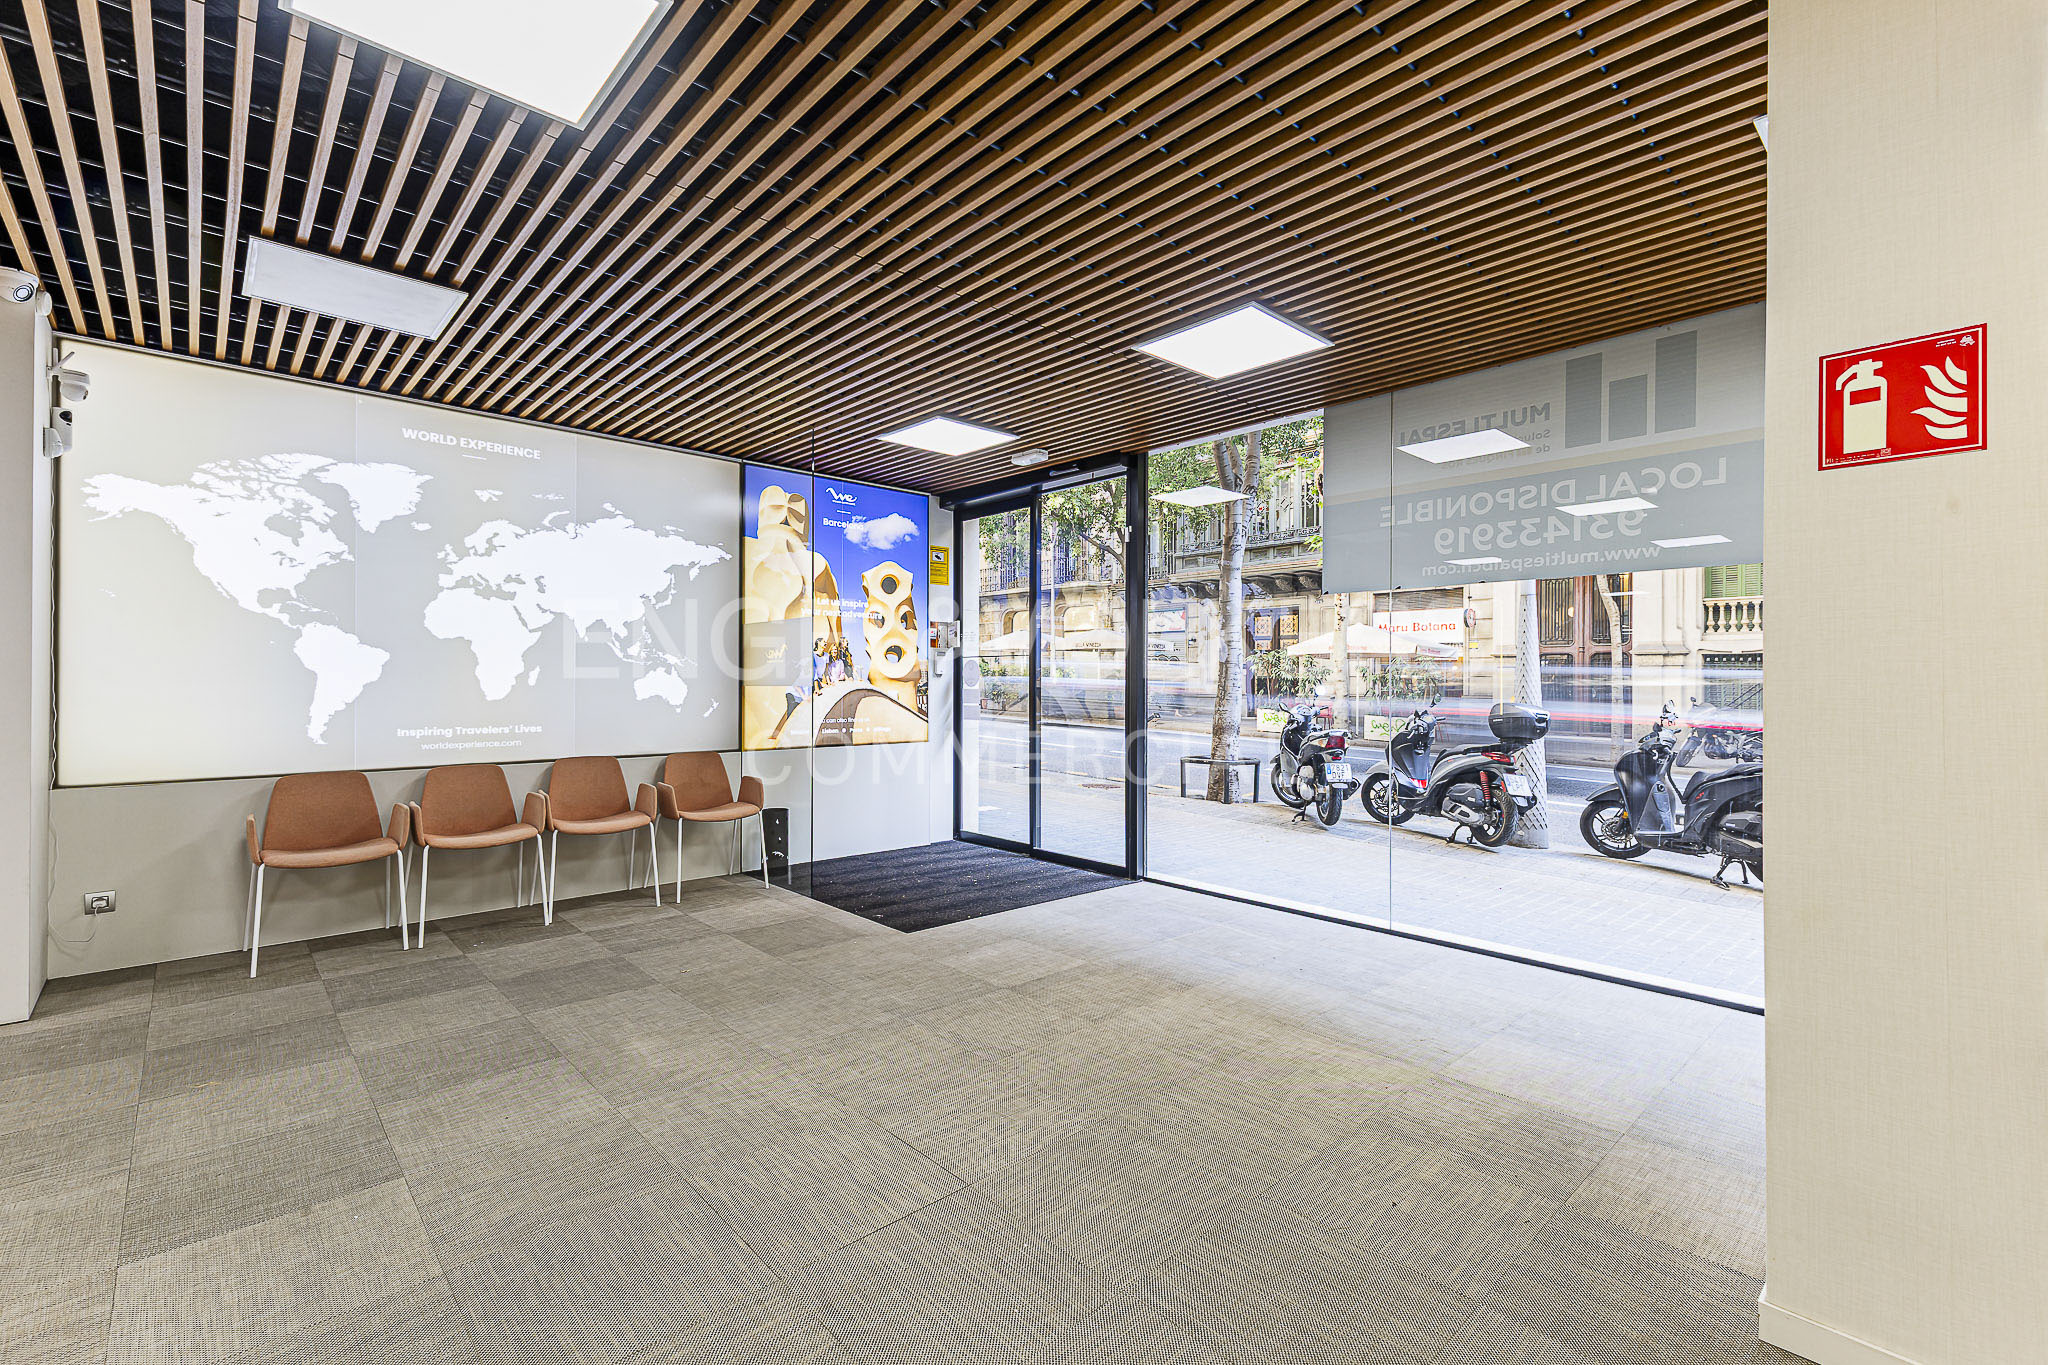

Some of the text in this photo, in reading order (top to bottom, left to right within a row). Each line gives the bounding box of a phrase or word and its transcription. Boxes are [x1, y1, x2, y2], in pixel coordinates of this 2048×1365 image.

[402, 427, 541, 460] WORLD EXPERIENCE
[816, 598, 830, 606] Let
[841, 598, 869, 610] inspire
[841, 610, 883, 620] adventure
[1378, 624, 1408, 633] Maru
[396, 723, 543, 739] Inspiring Travelers' Lives
[420, 739, 522, 751] worldexperience.com
